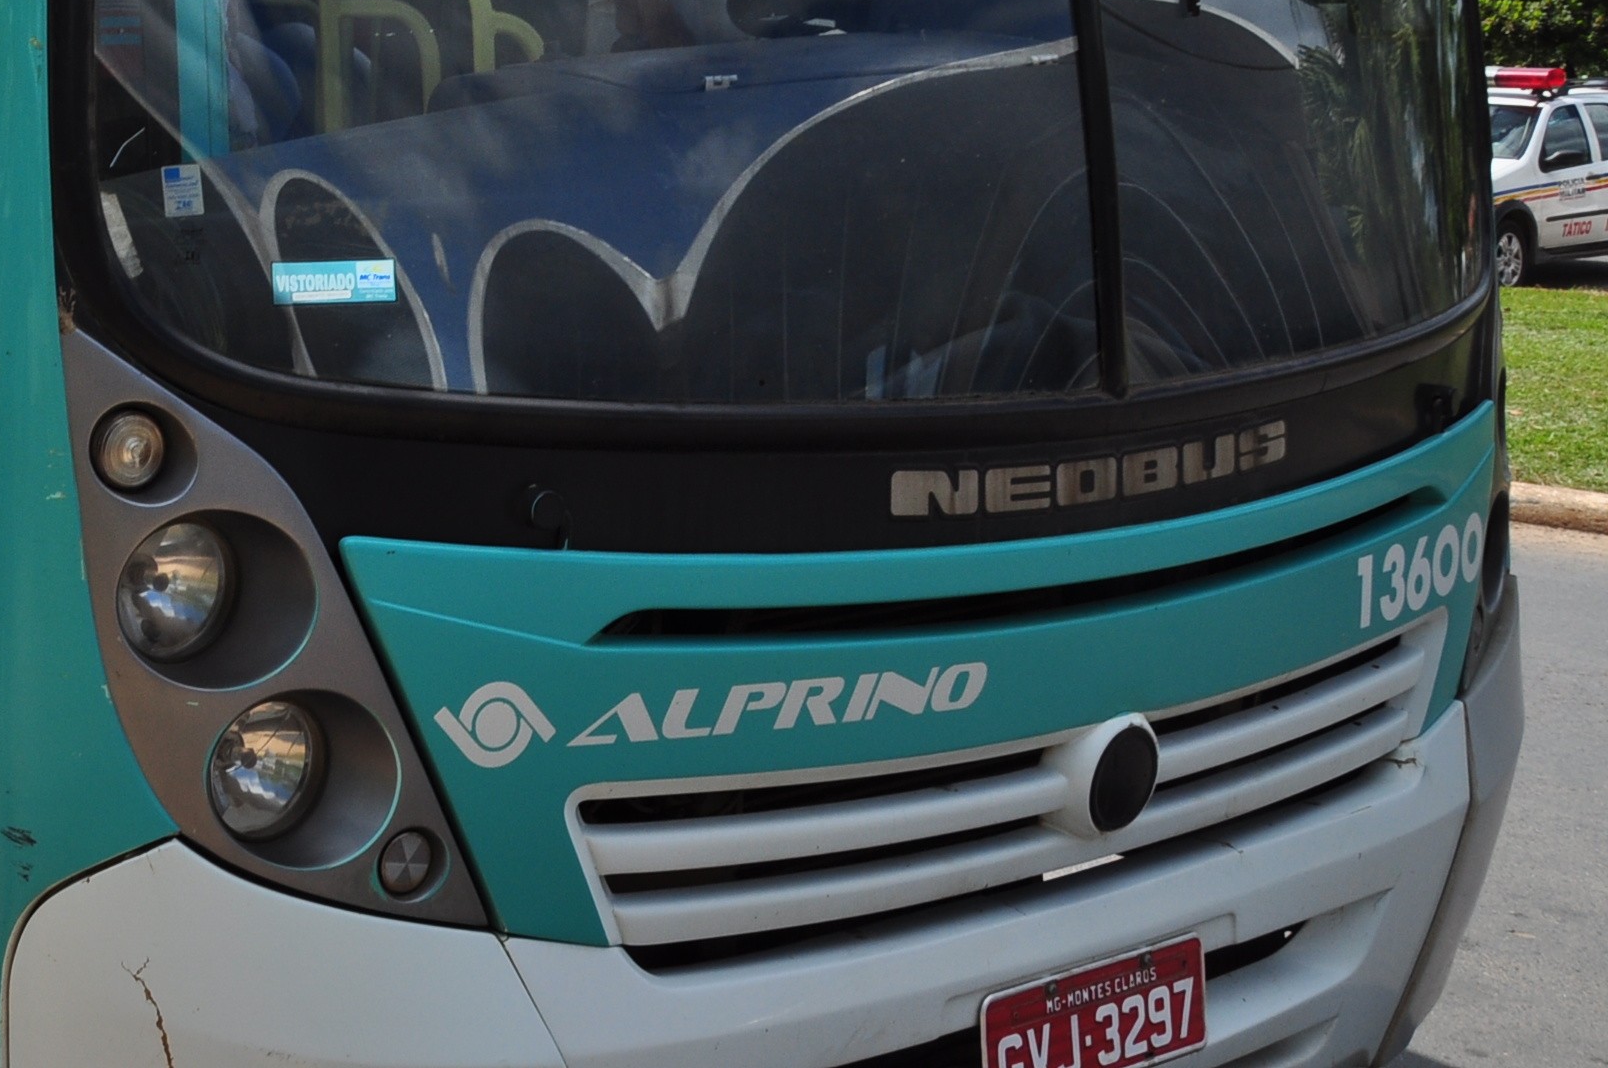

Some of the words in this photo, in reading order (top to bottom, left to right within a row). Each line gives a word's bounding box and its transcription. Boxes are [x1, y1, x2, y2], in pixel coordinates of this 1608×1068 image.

[276, 273, 356, 293] VISTORIADO
[890, 419, 1287, 518] NEOBUS
[1356, 511, 1484, 629] 13600
[567, 661, 990, 748] ALPRINO
[1114, 966, 1158, 995] CLAROS
